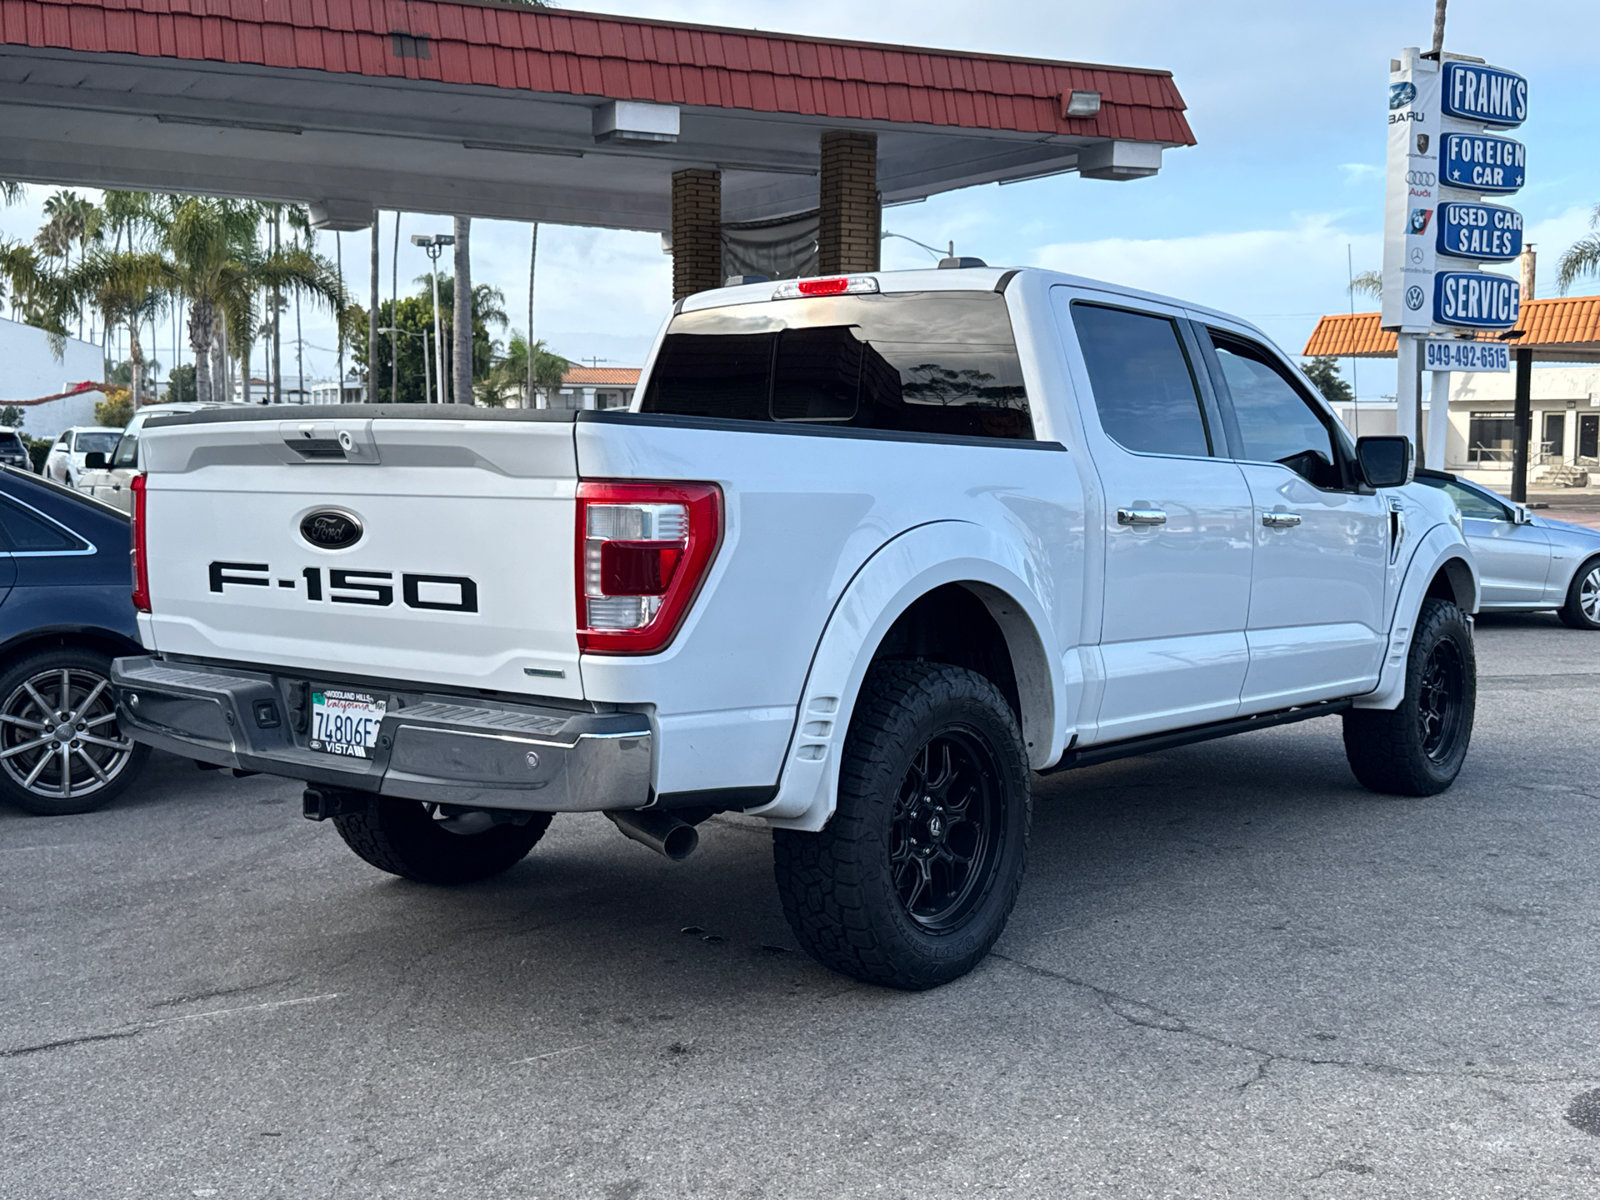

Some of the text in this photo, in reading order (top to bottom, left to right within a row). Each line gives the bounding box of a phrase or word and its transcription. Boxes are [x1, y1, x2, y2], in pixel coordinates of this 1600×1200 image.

[1454, 69, 1526, 120] FRANK'S
[1450, 137, 1524, 167] FOREIGN
[1472, 166, 1504, 185] CAR
[1408, 187, 1431, 198] Audi
[1450, 207, 1522, 231] USED CAR
[1459, 228, 1512, 255] SALES
[1445, 277, 1519, 321] SERVICE
[1427, 344, 1507, 369] 949-492-6515
[311, 517, 345, 540] Ford
[208, 560, 479, 613] F-150
[326, 690, 370, 701] WOODLAND HILLS
[325, 742, 355, 756] VISTA
